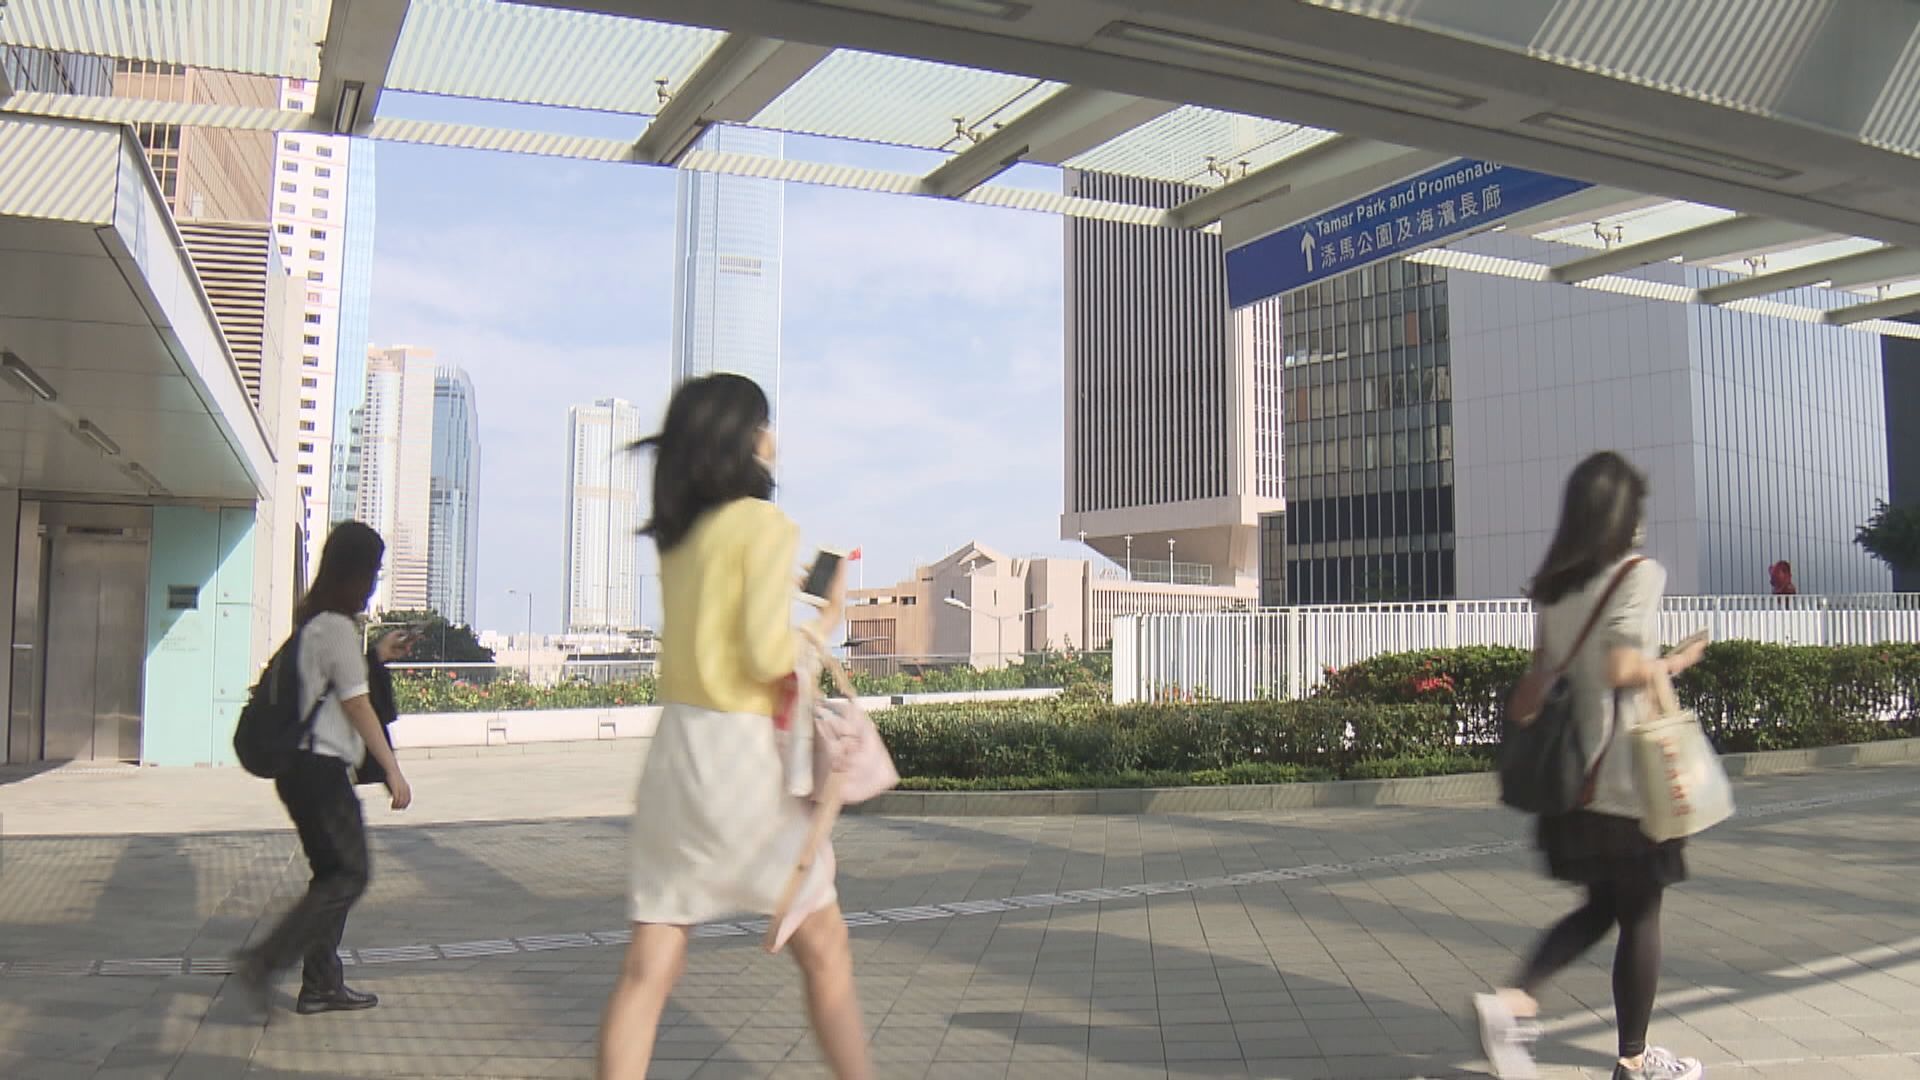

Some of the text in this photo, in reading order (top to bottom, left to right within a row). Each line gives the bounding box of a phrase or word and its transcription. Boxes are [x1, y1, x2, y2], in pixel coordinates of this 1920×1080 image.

[1316, 212, 1355, 236] Tamar
[1357, 199, 1386, 222] Park
[1389, 185, 1416, 209] and
[1321, 184, 1502, 269] 添馬公園及海濱長廊
